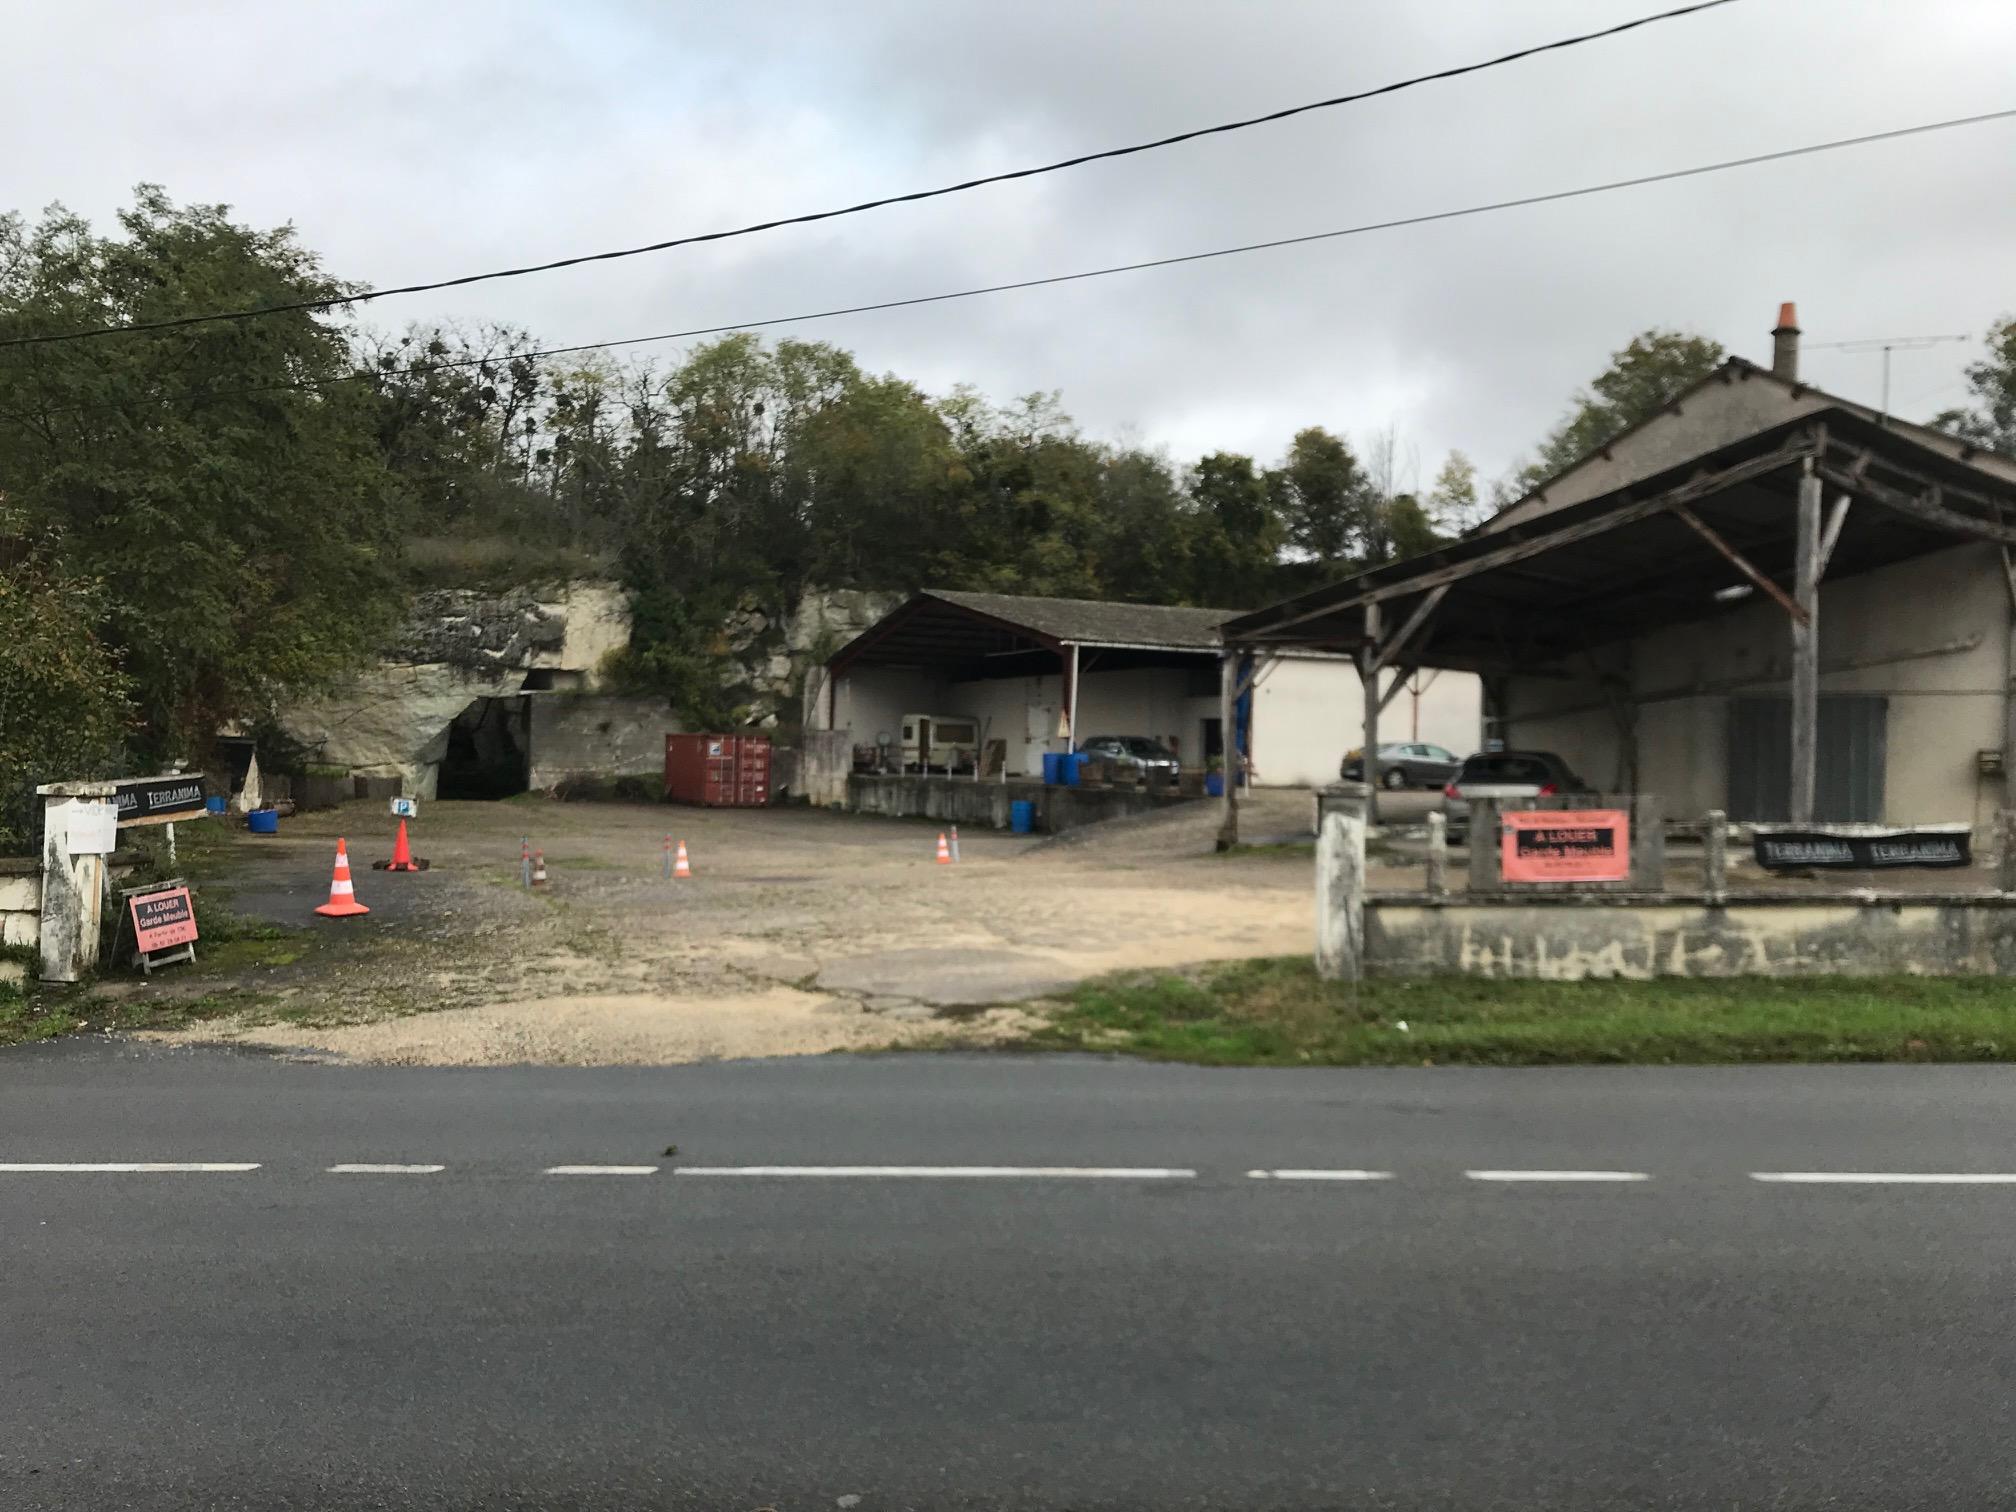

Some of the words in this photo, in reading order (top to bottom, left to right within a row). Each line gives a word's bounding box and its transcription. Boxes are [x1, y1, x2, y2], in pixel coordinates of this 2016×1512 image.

[147, 785, 201, 806] TERRANIMA
[1535, 832, 1545, 842] A
[1549, 831, 1596, 842] LOUER
[1764, 841, 1853, 858] TERRANIMA
[1870, 840, 1960, 858] TERRANIMA
[147, 905, 153, 913] A
[154, 898, 179, 912] LOUER
[140, 915, 162, 927] Garde
